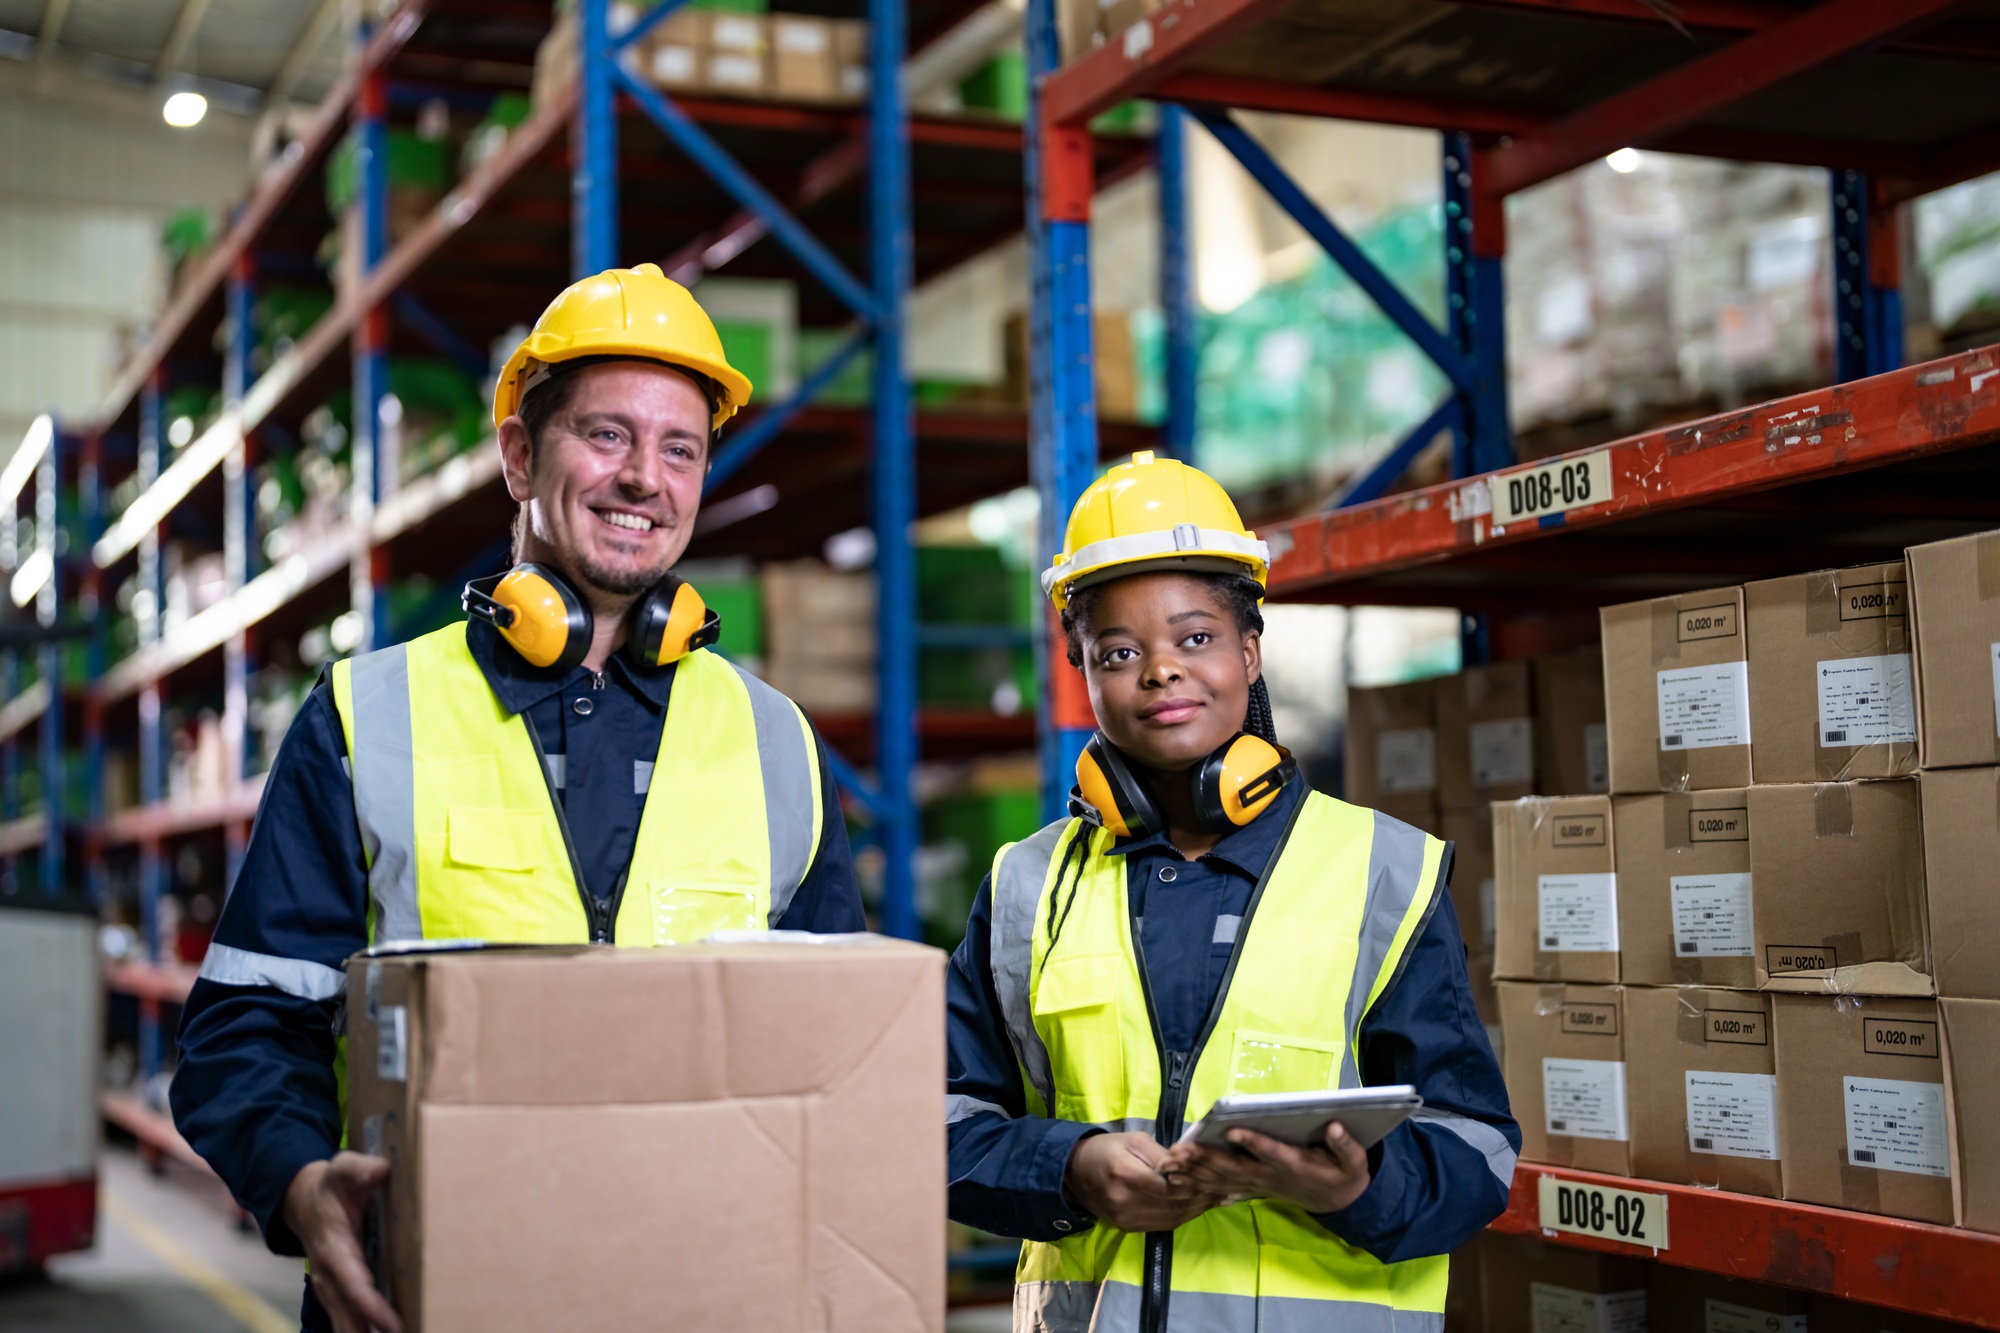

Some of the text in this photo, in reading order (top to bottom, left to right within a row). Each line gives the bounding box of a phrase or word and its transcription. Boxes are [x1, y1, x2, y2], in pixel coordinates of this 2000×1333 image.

[1509, 460, 1591, 516] D08-03
[1851, 593, 1883, 610] 0,020
[1686, 616, 1726, 632] 0,020 m³
[1698, 819, 1738, 834] 0,020 m³
[1795, 954, 1826, 970] 0,020
[1714, 1020, 1756, 1034] 0,020 m³
[1876, 1030, 1925, 1046] 0,020 m³
[1558, 1185, 1646, 1240] D08-02
